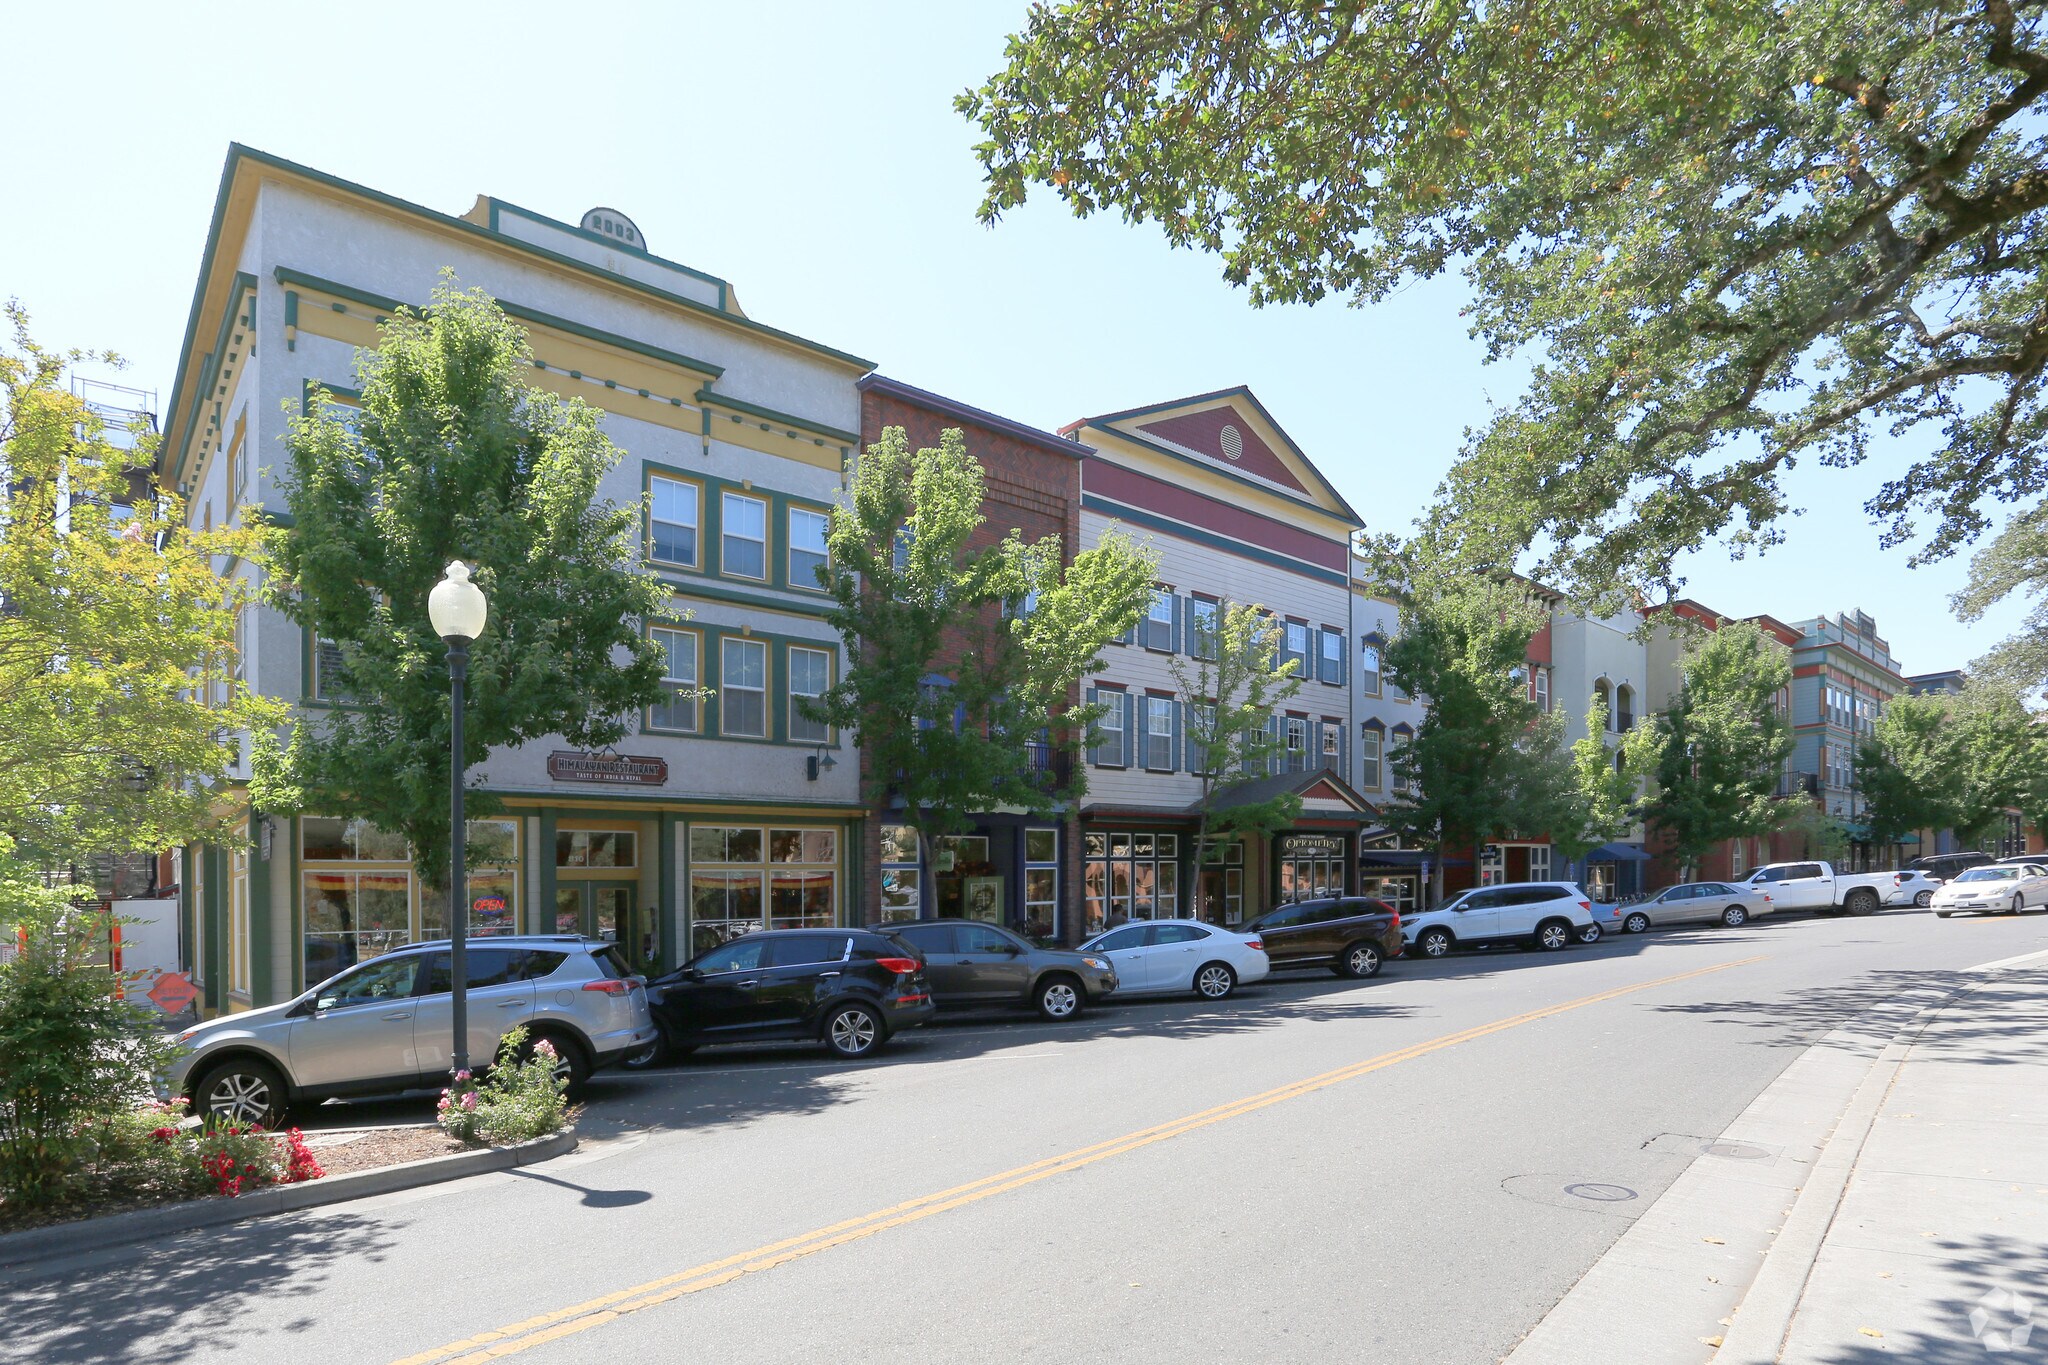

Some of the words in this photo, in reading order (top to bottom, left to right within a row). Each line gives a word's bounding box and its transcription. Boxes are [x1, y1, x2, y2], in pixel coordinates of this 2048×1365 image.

[592, 215, 634, 242] 2003
[557, 757, 608, 772] HIMALAYAN
[608, 760, 660, 776] RESTAURANT
[1286, 838, 1337, 849] OPTOMETRY
[473, 899, 506, 911] OPEN
